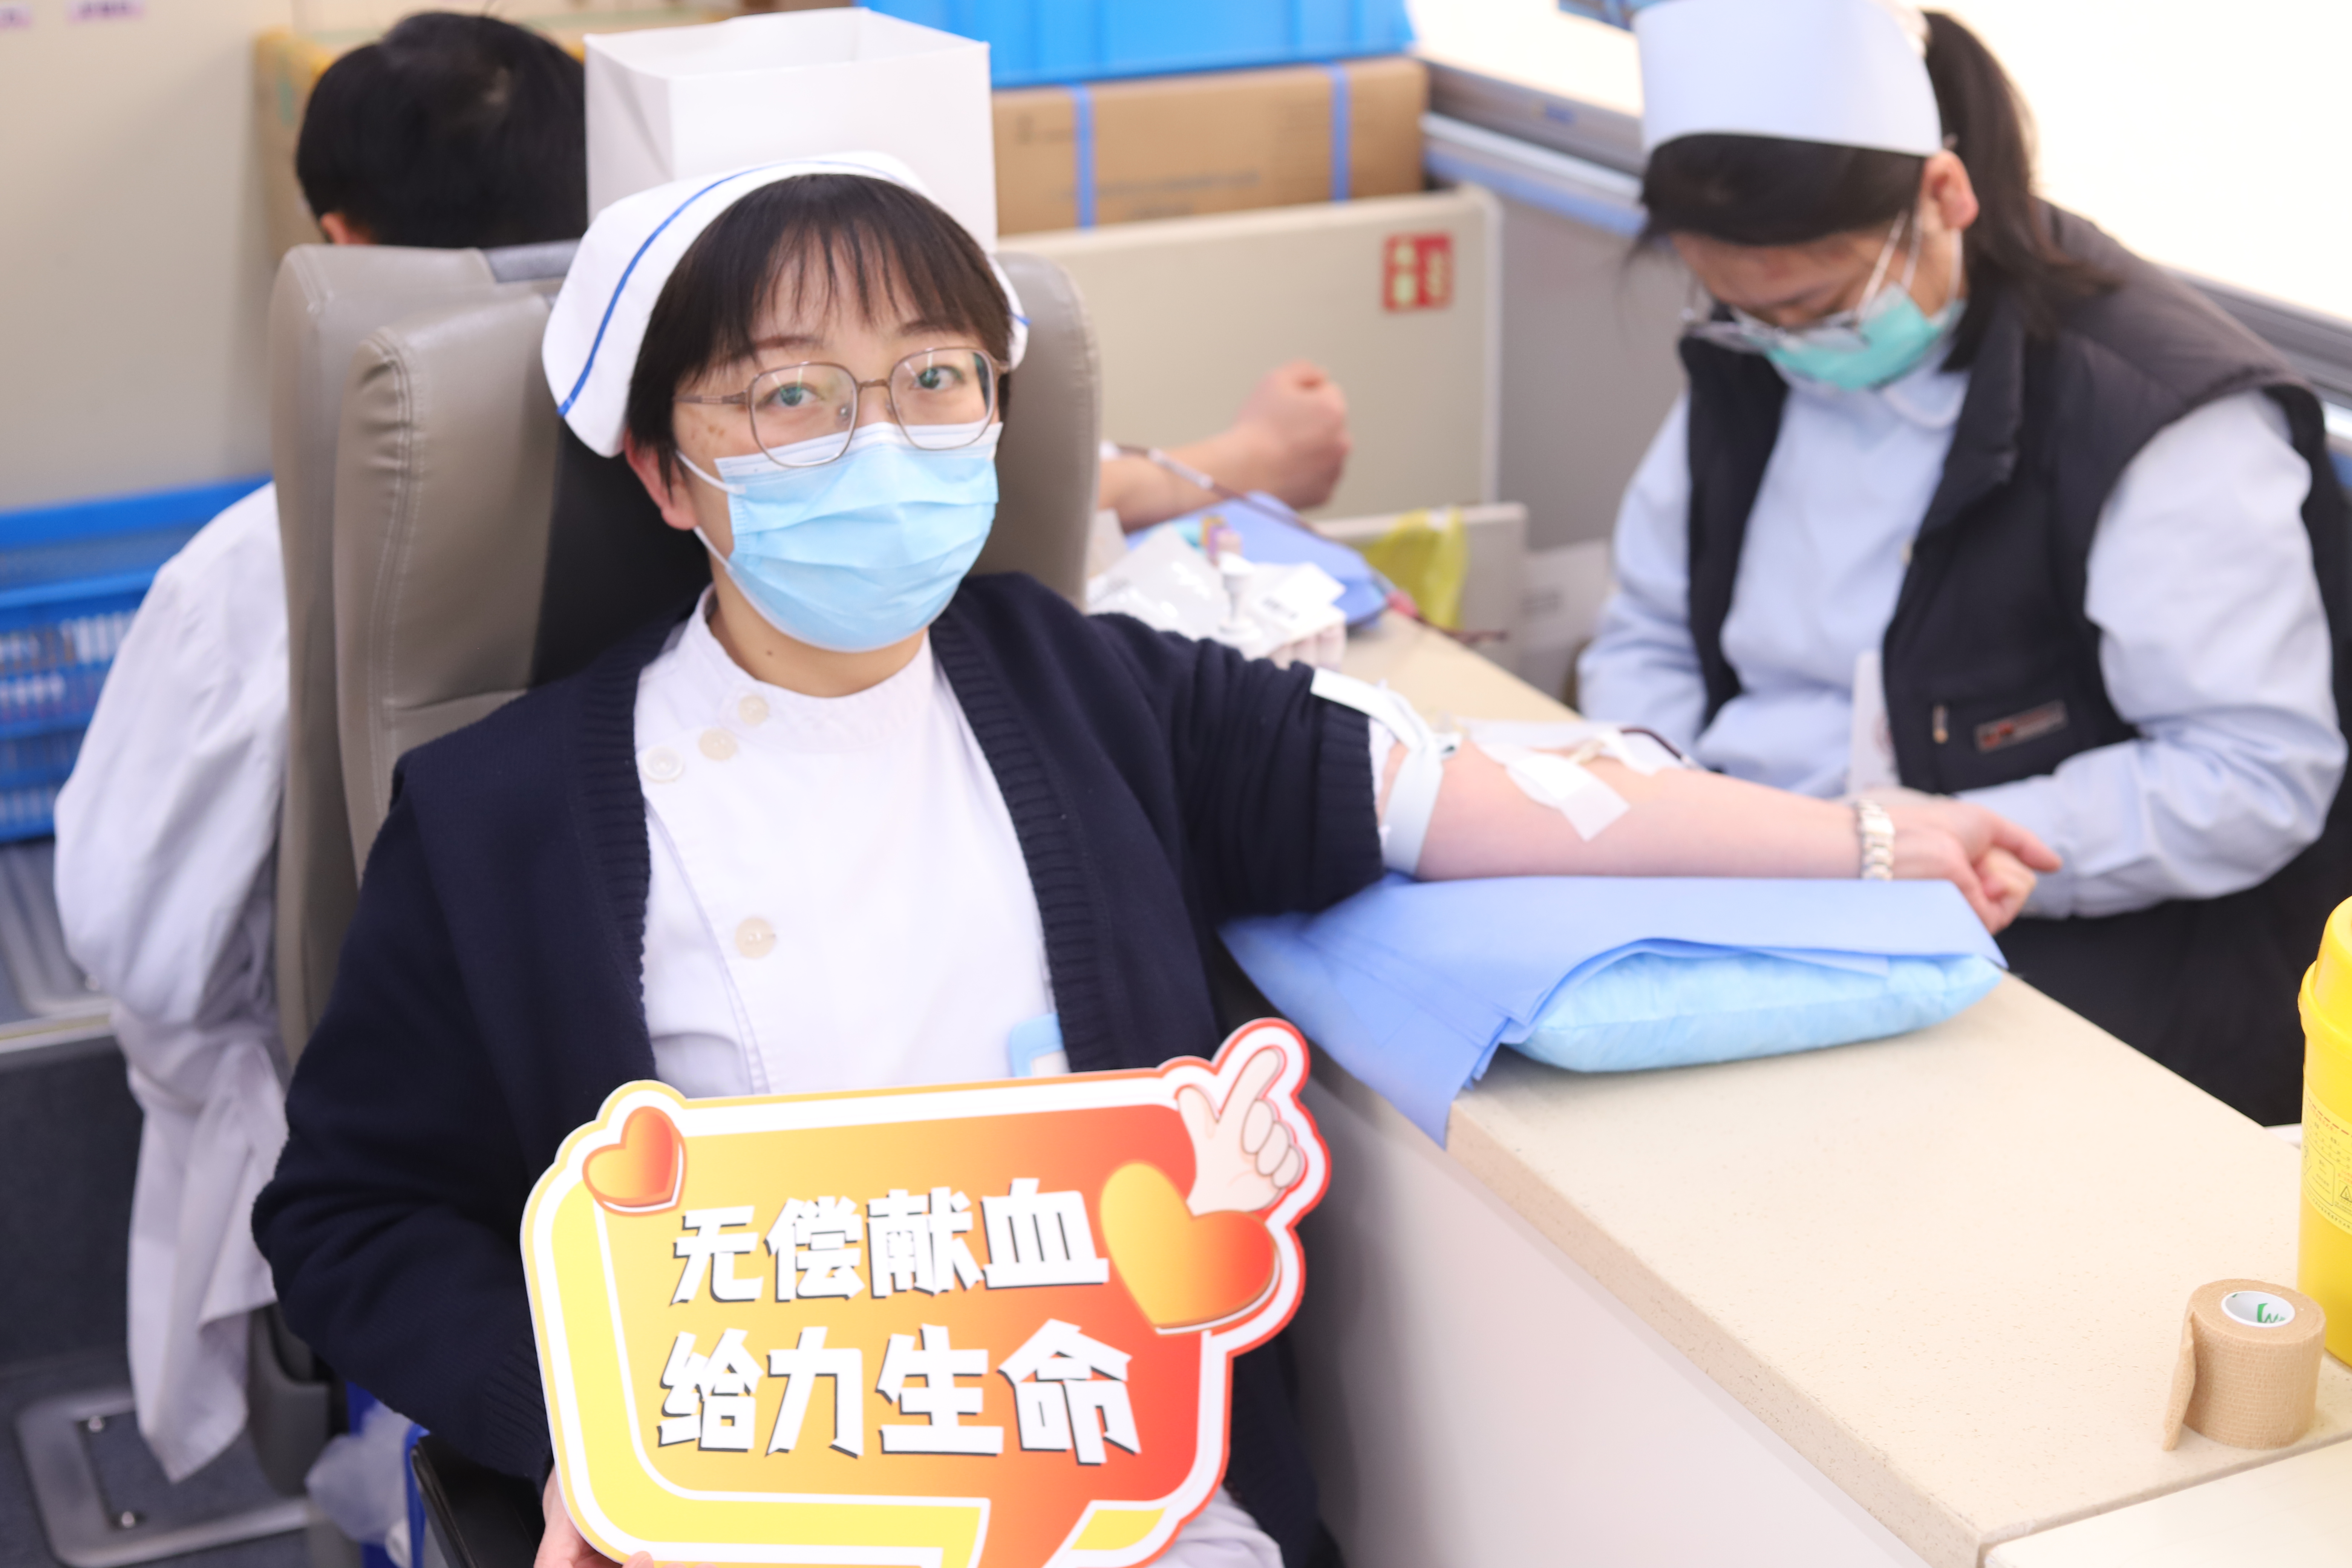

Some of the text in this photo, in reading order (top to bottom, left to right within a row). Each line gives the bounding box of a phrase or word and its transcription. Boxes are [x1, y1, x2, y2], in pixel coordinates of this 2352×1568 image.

[670, 1178, 1109, 1305] 无偿献血
[657, 1319, 1141, 1465] 给力生命
